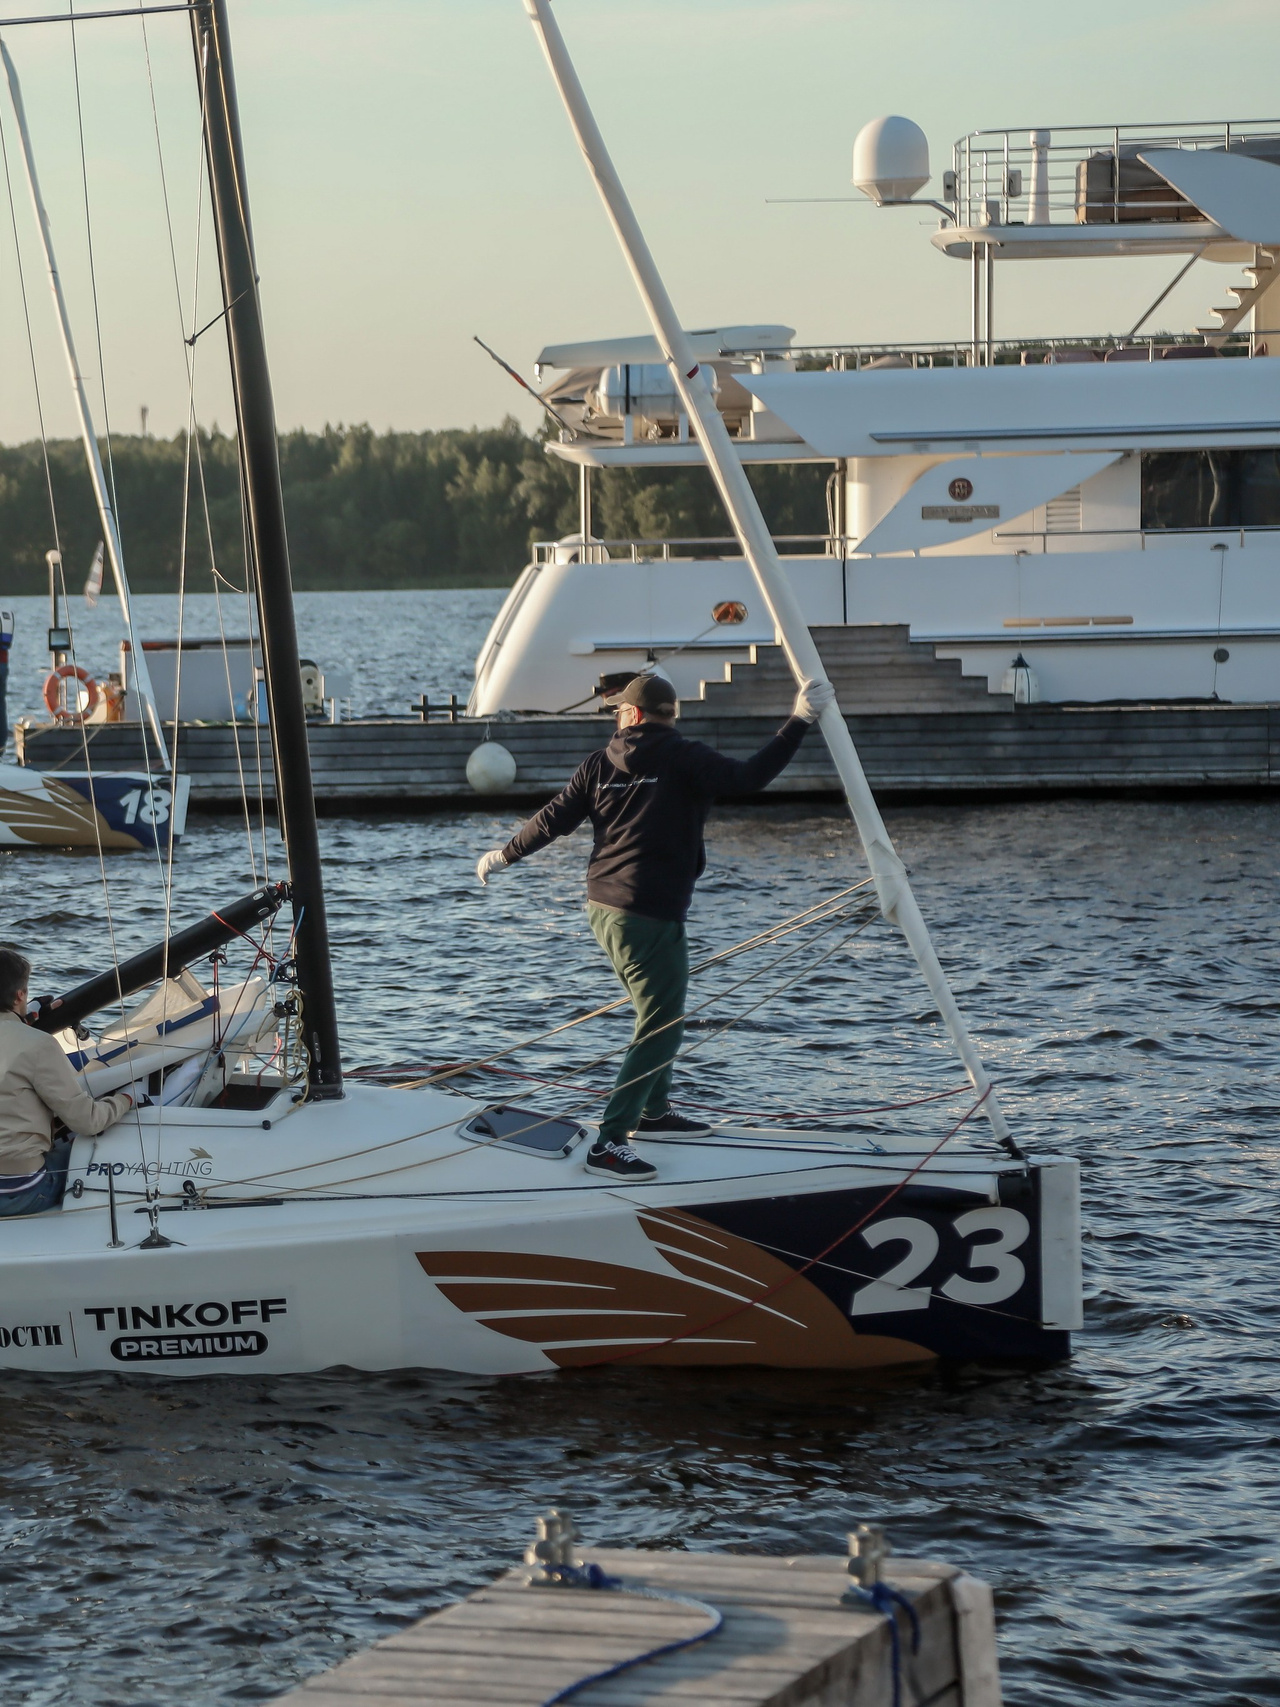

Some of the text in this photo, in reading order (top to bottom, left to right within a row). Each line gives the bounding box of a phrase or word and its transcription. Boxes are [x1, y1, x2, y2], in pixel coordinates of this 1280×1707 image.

[120, 789, 172, 824] 18
[86, 1161, 213, 1176] PROYACHTING
[851, 1206, 1030, 1316] 23
[84, 1298, 287, 1331] TINKOFF
[120, 1335, 259, 1357] PREMIUM
